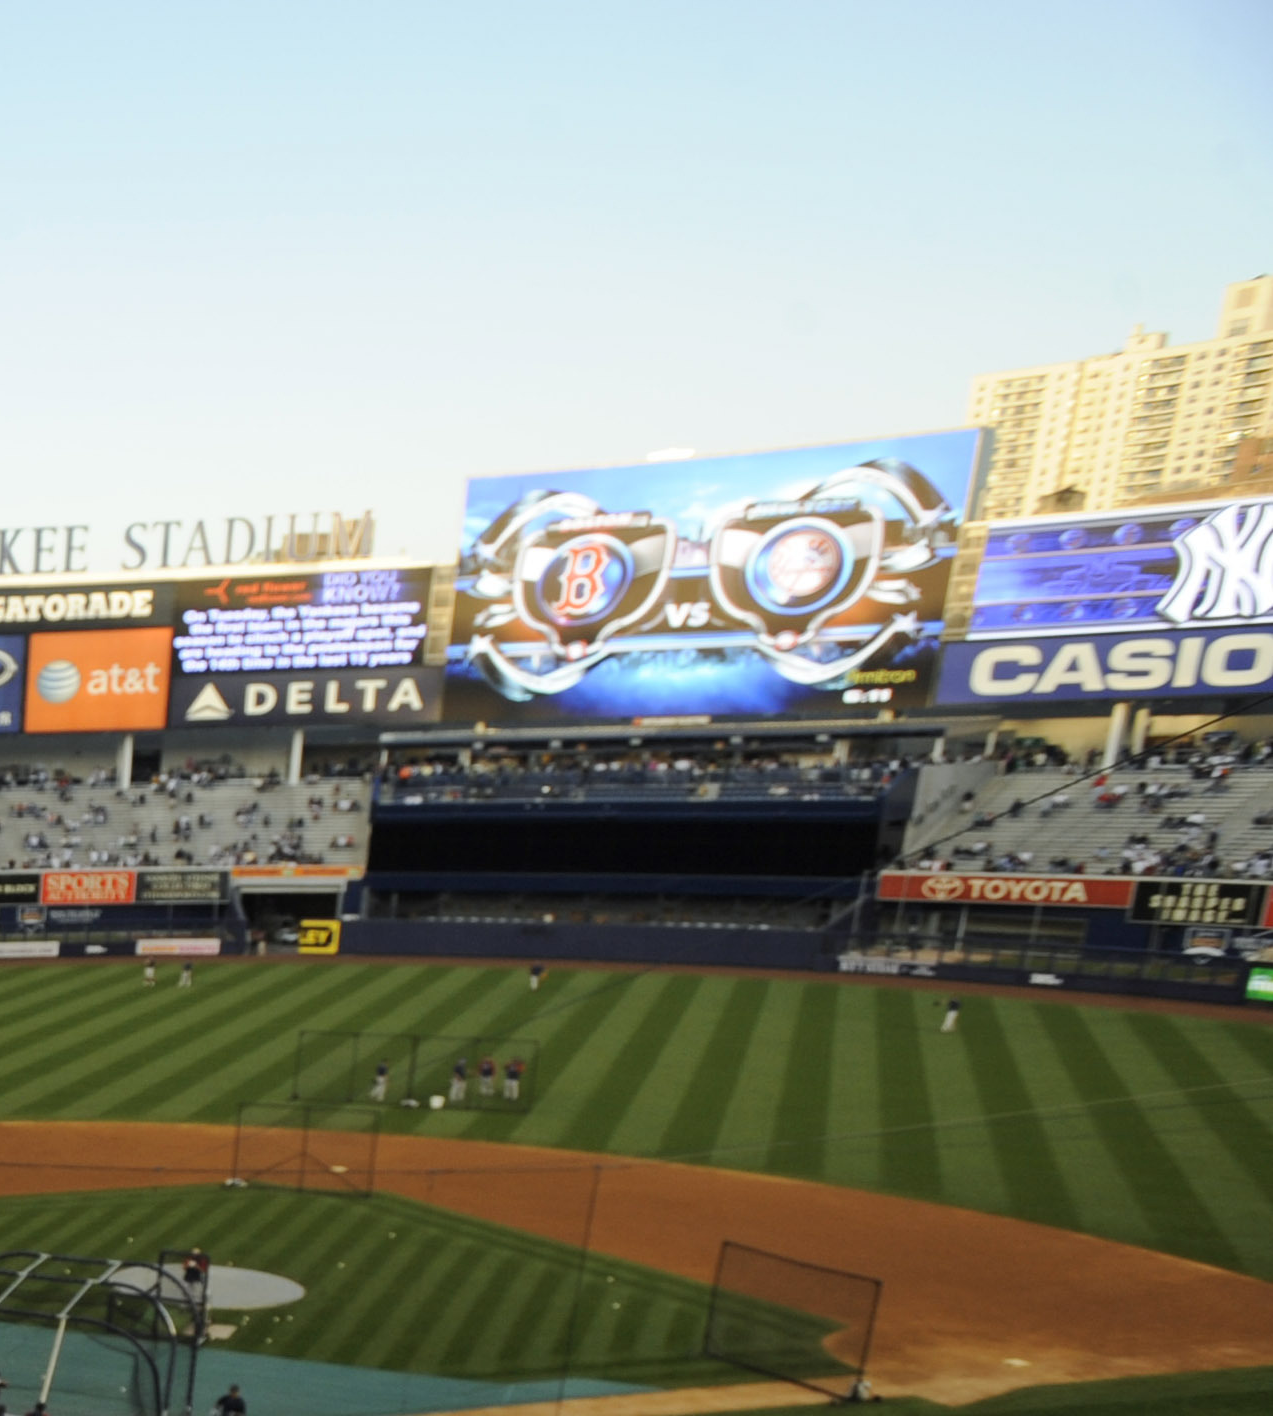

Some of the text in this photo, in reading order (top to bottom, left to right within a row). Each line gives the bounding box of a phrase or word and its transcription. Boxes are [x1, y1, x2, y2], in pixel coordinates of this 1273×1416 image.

[120, 508, 377, 571] STADIUM
[324, 569, 399, 586] DID YOU
[664, 601, 711, 628] VS
[86, 661, 161, 696] at&t
[969, 633, 1273, 696] CASIO
[243, 677, 424, 716] DELTA
[47, 872, 130, 891] SPORTS
[967, 878, 1088, 903] TOYOTA
